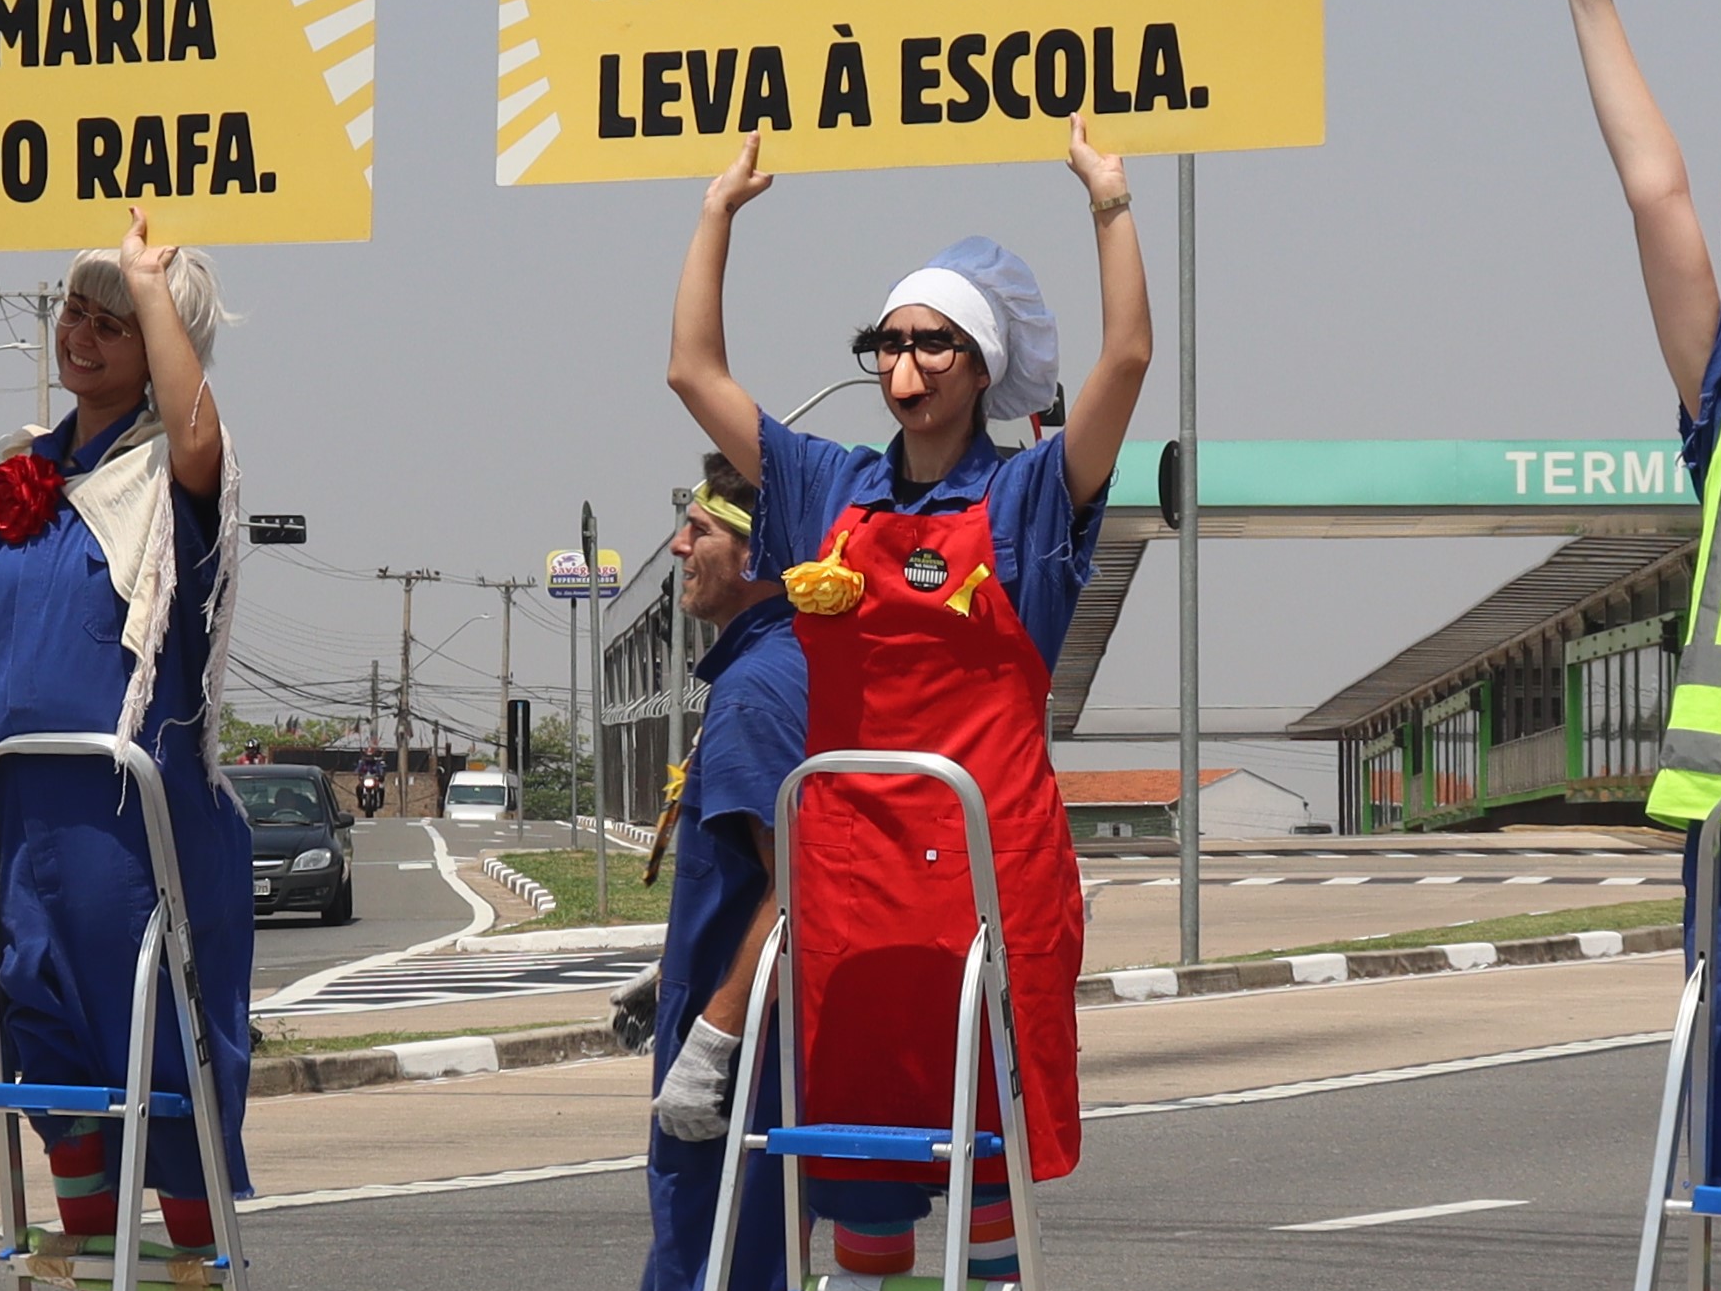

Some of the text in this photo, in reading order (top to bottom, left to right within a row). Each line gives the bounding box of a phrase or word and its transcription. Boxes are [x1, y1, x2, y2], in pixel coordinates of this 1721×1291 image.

[598, 23, 1209, 139] LEVA À ESCOLA.
[76, 112, 277, 200] RAFA.
[1505, 451, 1686, 494] TERMI
